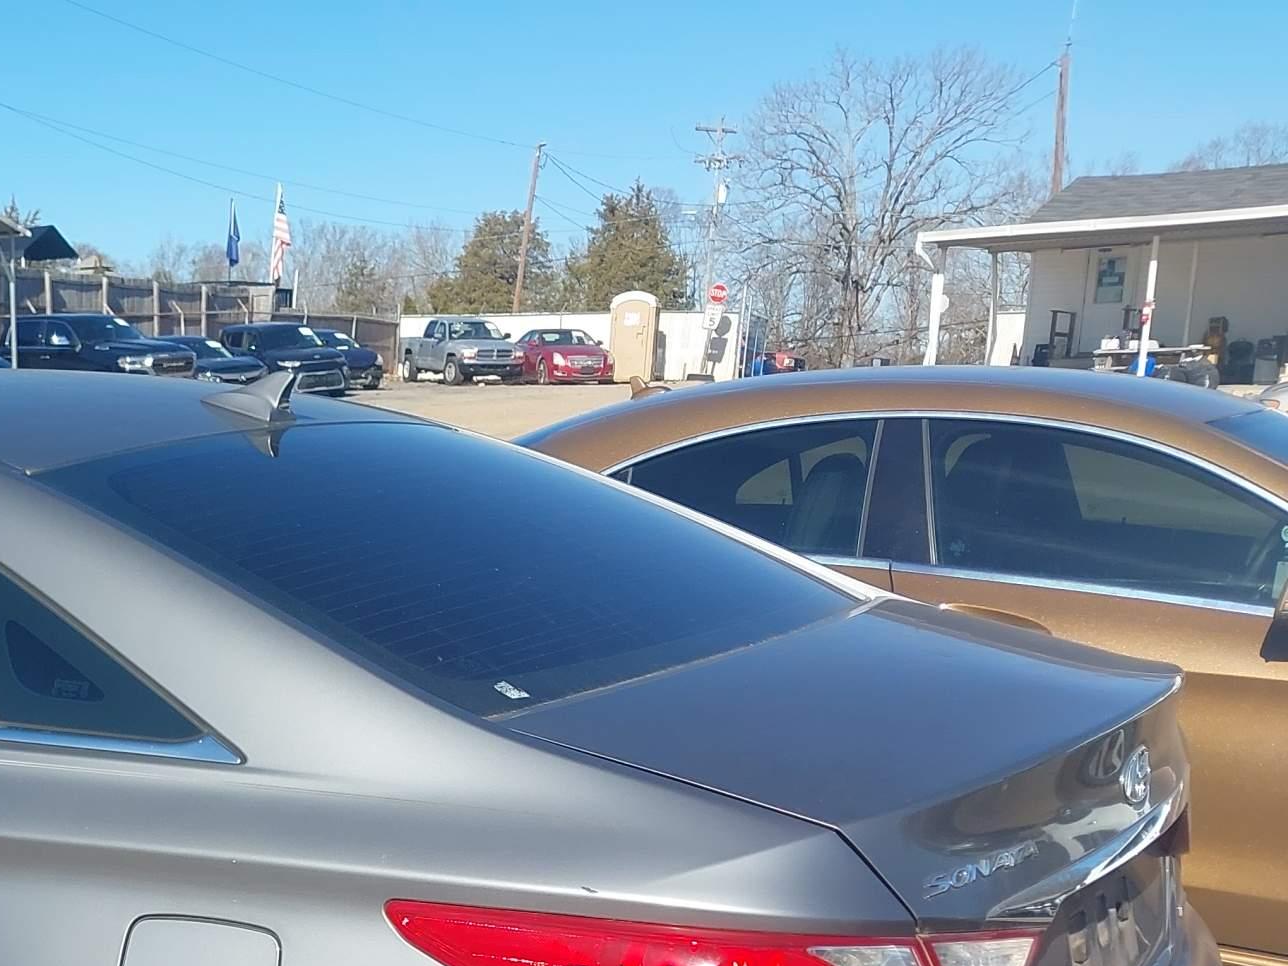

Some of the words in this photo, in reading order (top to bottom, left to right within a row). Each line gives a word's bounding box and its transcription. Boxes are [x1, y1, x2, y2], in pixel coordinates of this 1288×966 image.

[710, 288, 727, 298] STOP
[708, 317, 715, 327] 5
[923, 840, 1039, 900] SONATA
